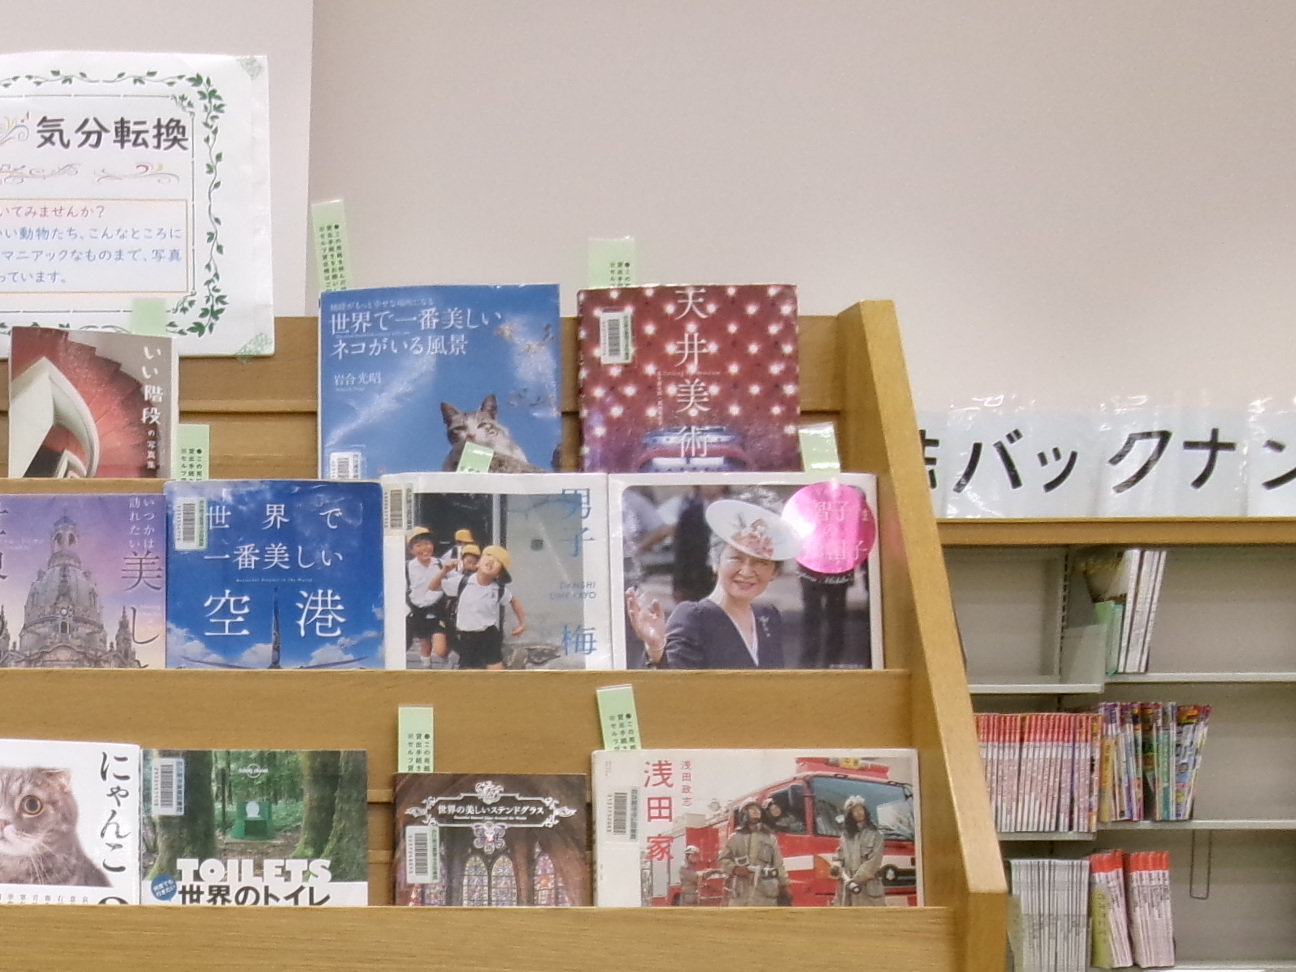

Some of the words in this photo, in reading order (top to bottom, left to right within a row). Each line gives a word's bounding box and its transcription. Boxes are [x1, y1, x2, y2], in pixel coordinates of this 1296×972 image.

[35, 115, 190, 152] 気分転換
[328, 307, 503, 336] 世界で一番美しい
[330, 333, 469, 361] ネコがいる風景
[332, 370, 383, 387] 岩合光昭
[918, 427, 1296, 494] バックナン
[129, 496, 141, 549] 訪れたい
[143, 498, 155, 549] いつかは
[204, 503, 341, 531] 世界で
[559, 487, 596, 558] 男子
[203, 542, 344, 571] 一番美しい
[203, 588, 347, 639] 空港
[560, 623, 598, 657] 梅
[679, 759, 694, 808] 浅田政志
[437, 803, 545, 817] 世界の美しいステンドグラス
[642, 759, 675, 862] 浅田家
[175, 858, 333, 885] TOILETS
[177, 884, 332, 906] 世界のトイレ
